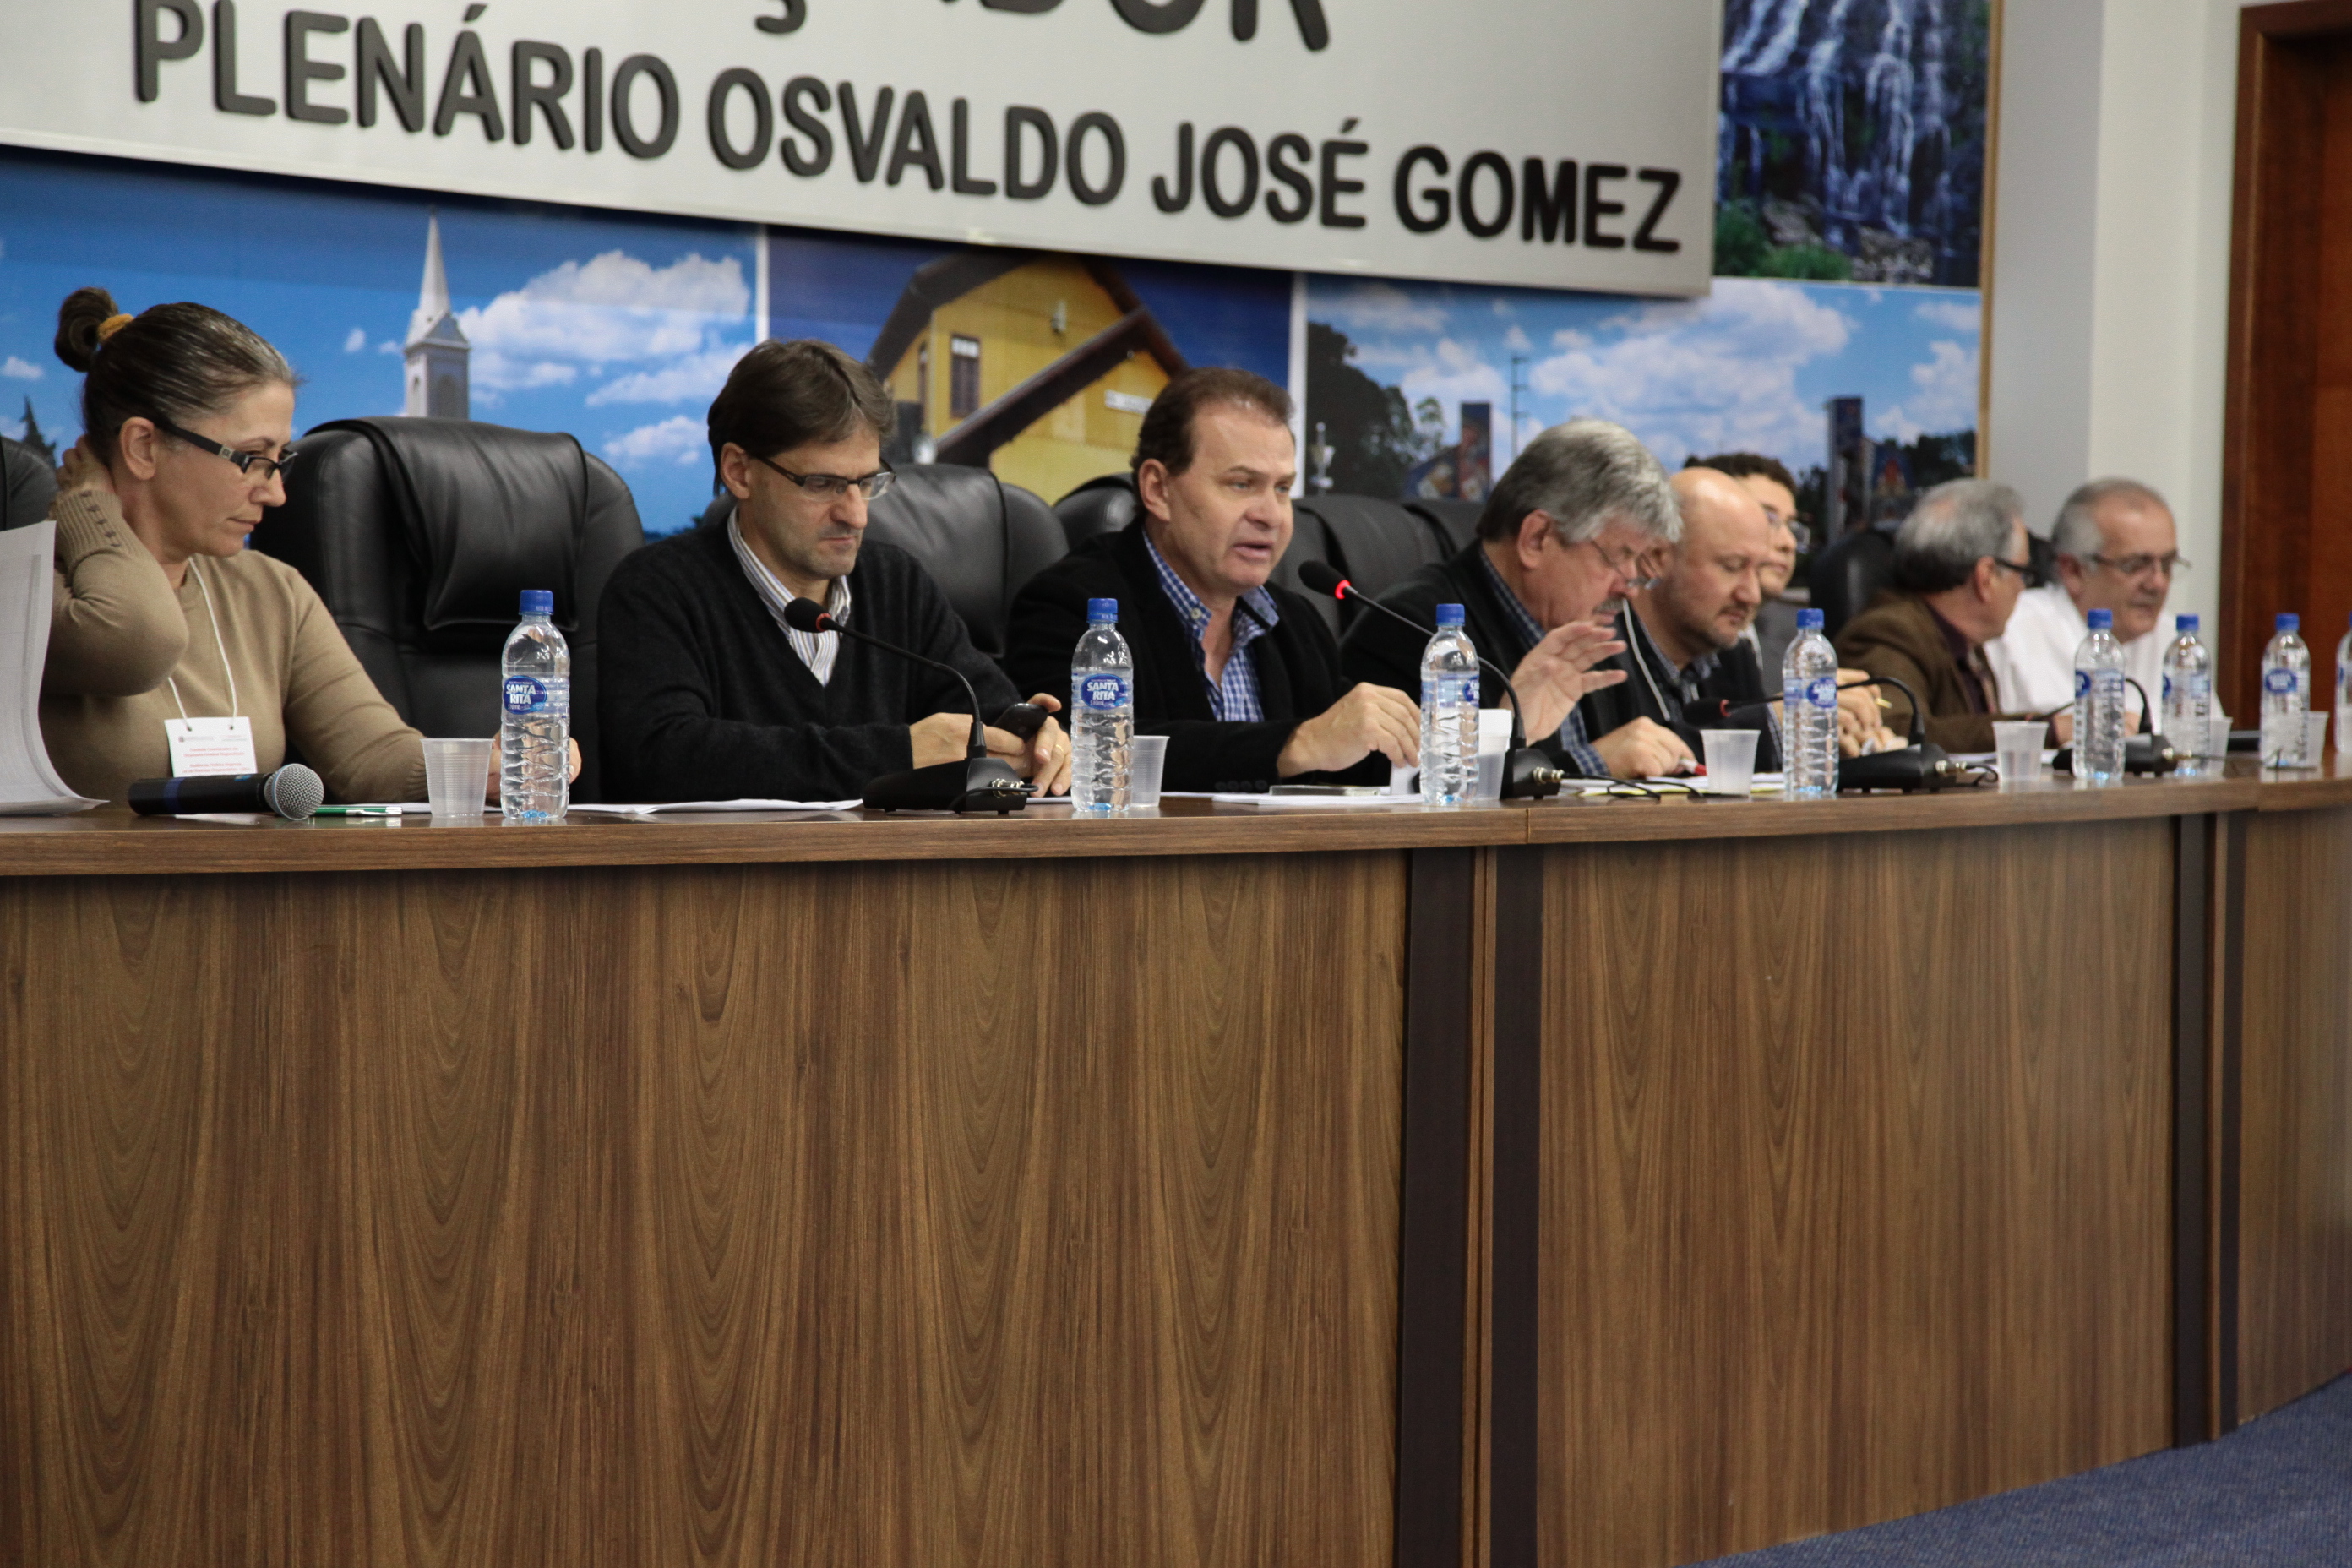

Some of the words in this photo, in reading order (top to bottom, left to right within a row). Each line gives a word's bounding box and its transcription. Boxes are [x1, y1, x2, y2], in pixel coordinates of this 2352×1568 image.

[133, 0, 680, 161] PLENÁRIO
[706, 68, 1126, 208] OSVALDO
[1151, 117, 1369, 231] JOSÉ
[1393, 144, 1682, 253] GOMEZ
[506, 684, 536, 694] SANTA
[1086, 682, 1119, 692] SANTA
[509, 694, 532, 705] RITA
[1092, 691, 1116, 700] RITA
